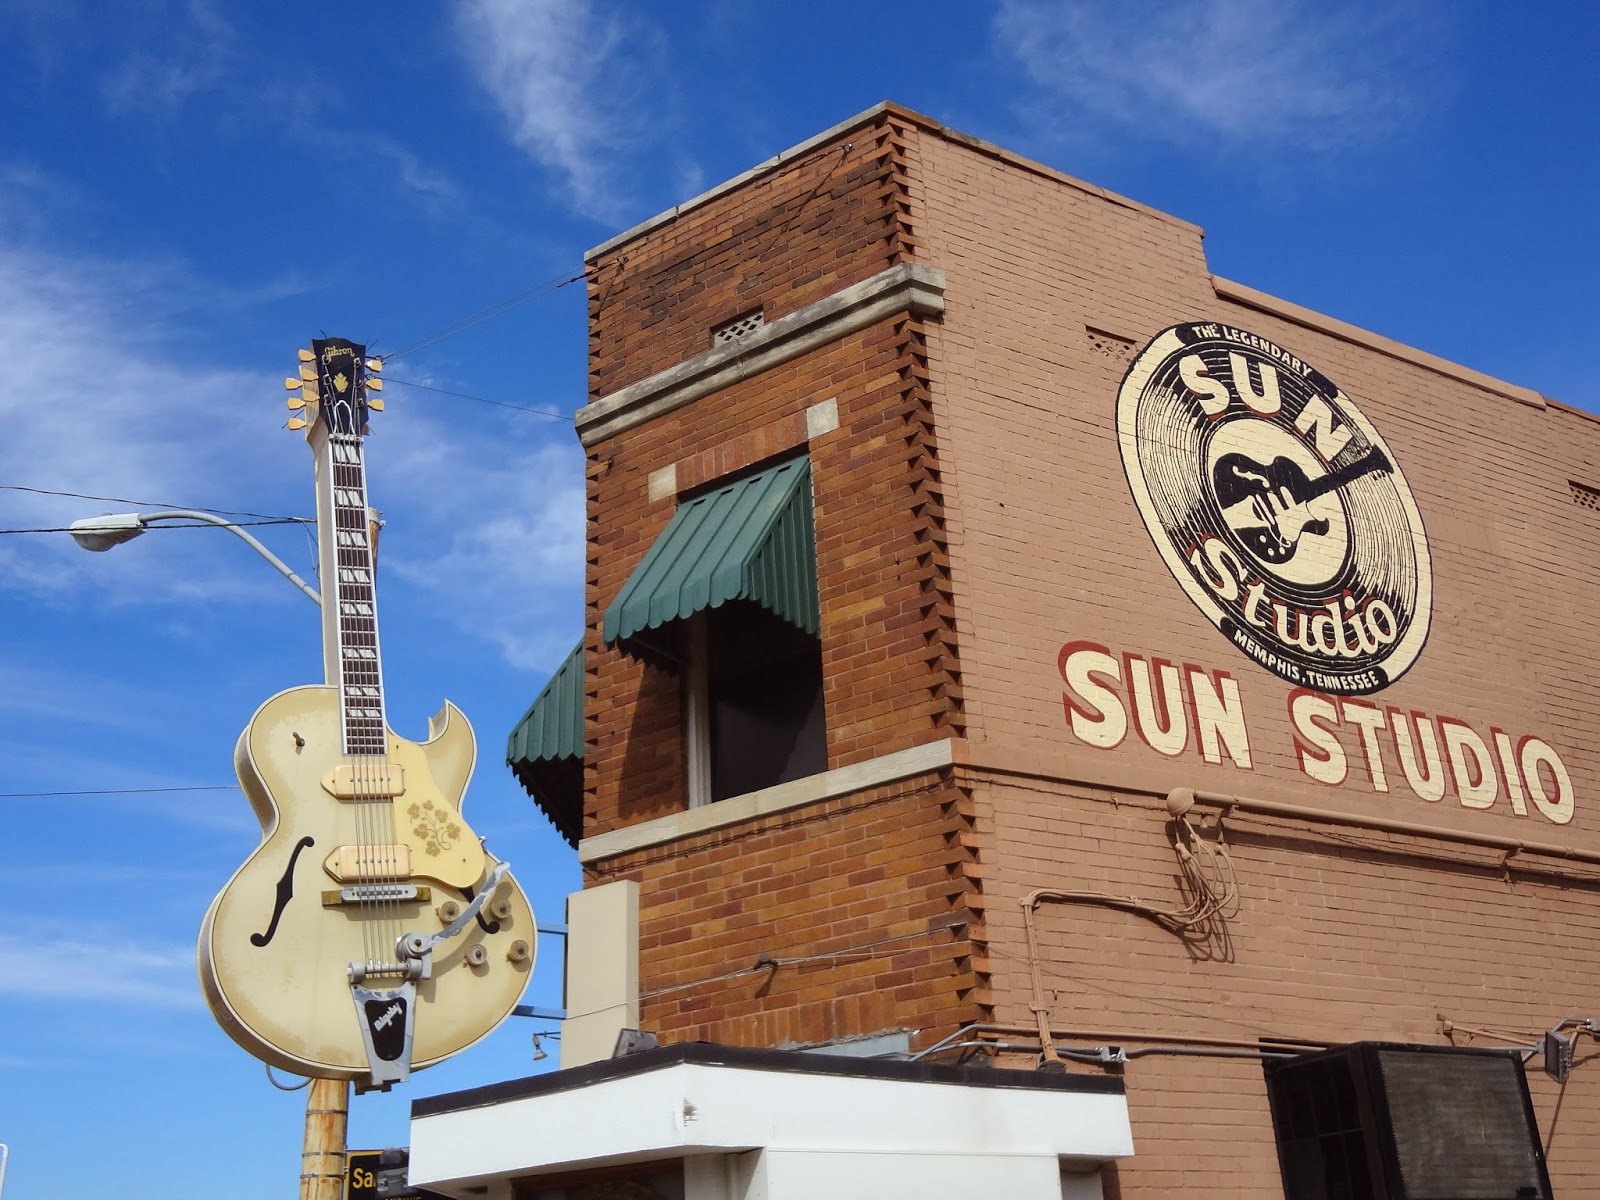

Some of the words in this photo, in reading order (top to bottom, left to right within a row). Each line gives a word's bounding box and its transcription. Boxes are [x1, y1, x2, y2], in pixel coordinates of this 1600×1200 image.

[324, 345, 355, 358] Gibson
[1192, 324, 1220, 339] THE
[1222, 325, 1313, 377] LEGENDARY
[1178, 351, 1353, 463] SUN
[1187, 533, 1397, 658] Studio
[1306, 670, 1379, 690] TENNESSEE
[1057, 640, 1253, 770] SUN
[1288, 687, 1575, 825] STUDIO
